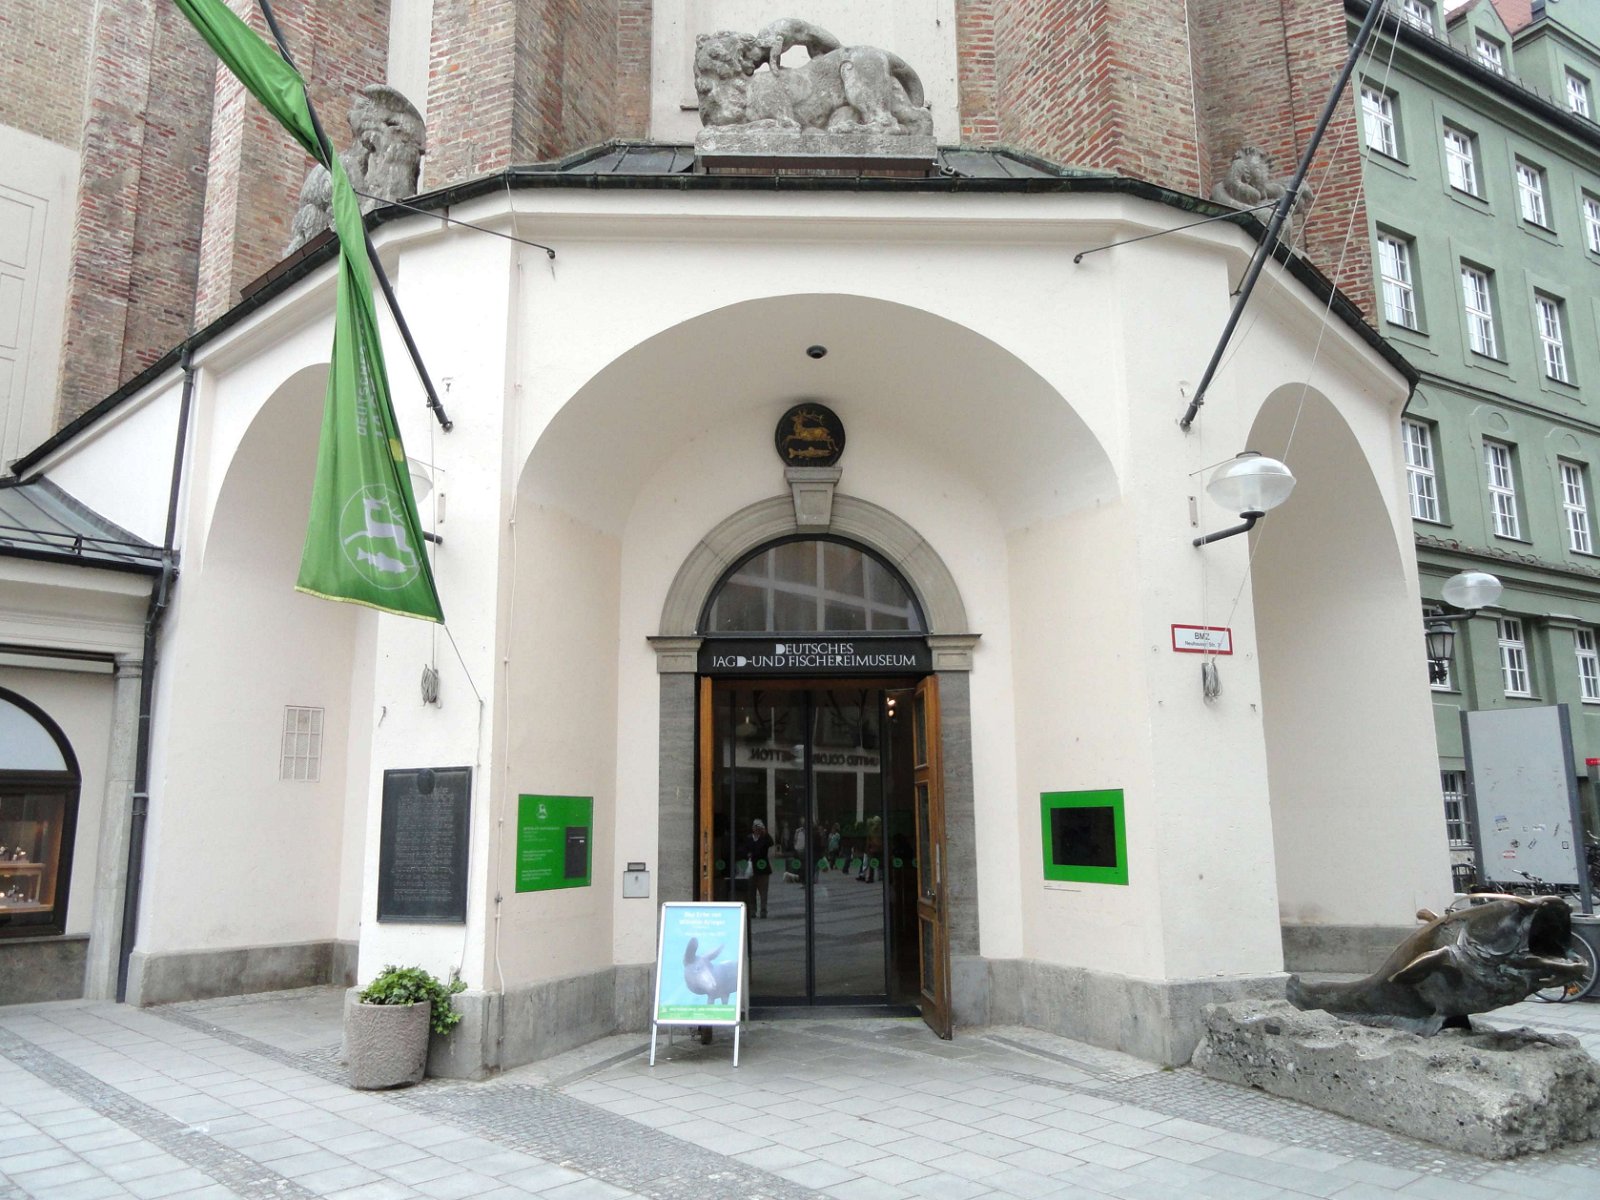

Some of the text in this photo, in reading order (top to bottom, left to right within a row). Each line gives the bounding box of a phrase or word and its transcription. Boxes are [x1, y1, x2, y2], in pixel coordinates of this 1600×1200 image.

[1194, 632, 1210, 641] BMZ
[775, 642, 854, 655] DEUTSCHES
[788, 654, 916, 667] FISCHEREIMUSEUM
